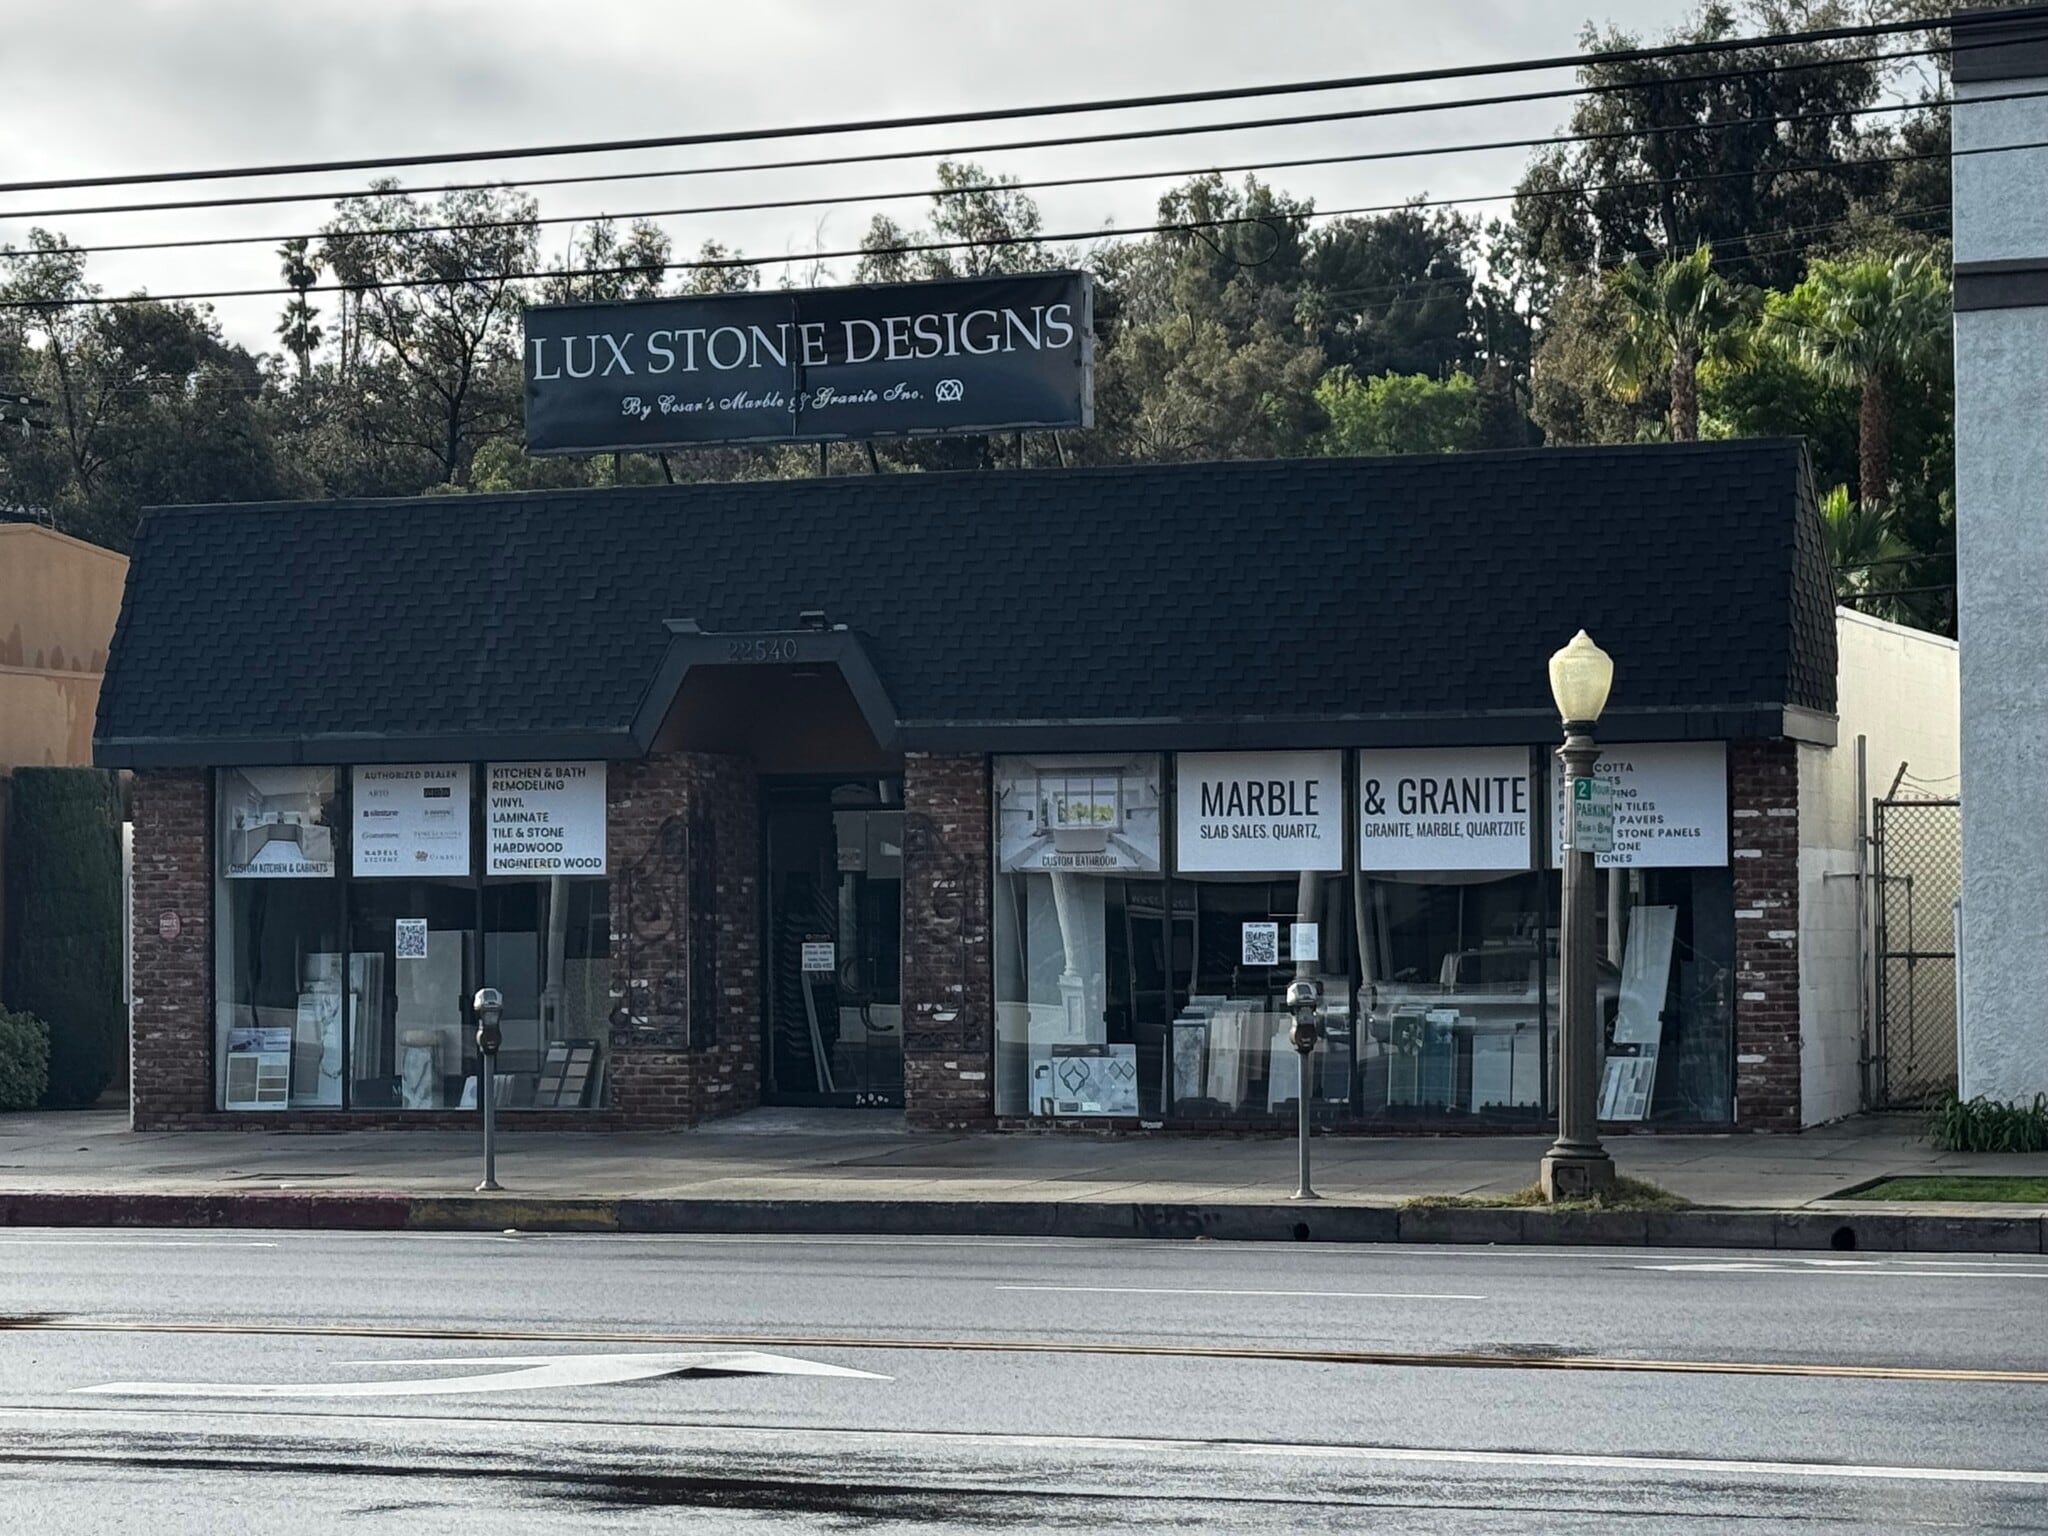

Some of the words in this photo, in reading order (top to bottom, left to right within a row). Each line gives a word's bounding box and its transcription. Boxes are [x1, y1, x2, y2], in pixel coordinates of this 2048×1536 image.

[531, 332, 636, 381] LUX
[647, 321, 828, 376] STONE
[841, 303, 1075, 364] DESIGNS
[621, 396, 652, 421] By
[657, 394, 715, 416] Cesar's
[719, 389, 785, 411] Marble
[787, 391, 811, 413] &
[811, 386, 878, 410] Granite
[883, 381, 924, 402] Inc.
[727, 638, 798, 661] 22540
[364, 770, 421, 780] AUTHORIZED
[424, 769, 457, 779] DEALER
[492, 767, 541, 779] KITCHEN
[543, 767, 553, 778] &
[555, 767, 586, 778] BATH
[492, 780, 565, 791] REMODELING
[1577, 780, 1587, 798] 2
[1201, 780, 1319, 817] MARBLE
[1364, 778, 1386, 815] &
[1398, 776, 1526, 815] GRANITE
[491, 797, 524, 808] VINYL
[1627, 802, 1656, 812] TILES
[1576, 802, 1611, 818] PARKING
[493, 812, 549, 823] LAMINATE
[1619, 815, 1665, 824] PAVERS
[492, 827, 513, 838] TILE
[515, 827, 525, 838] &
[526, 827, 565, 838] STONE
[1200, 824, 1229, 839] SLAB
[1416, 821, 1464, 838] MARBLE,
[1466, 821, 1526, 838] QUARTZITE
[1617, 828, 1656, 838] STONE
[1658, 827, 1701, 838] PANELS
[493, 842, 564, 854] HARDWOOD
[493, 858, 561, 869] ENGINEERED
[563, 857, 602, 868] WOOD
[1042, 856, 1073, 867] CUSTOM
[1075, 855, 1117, 867] BATHROOM
